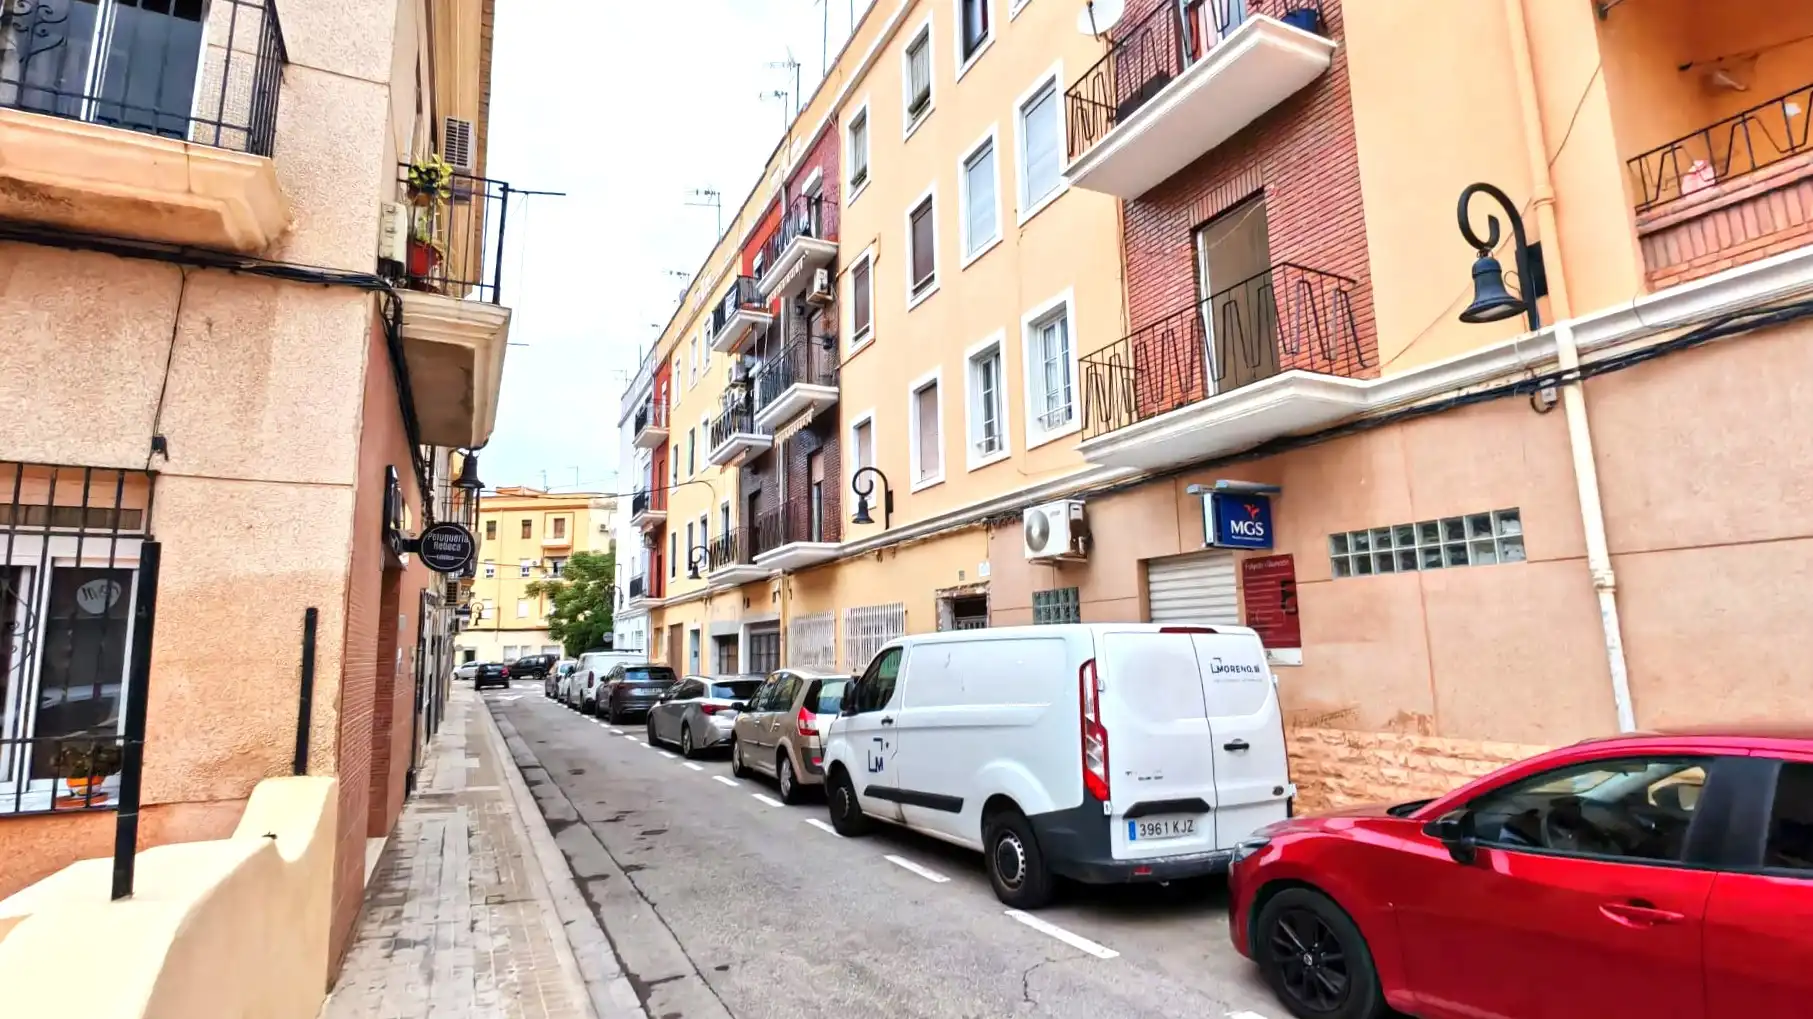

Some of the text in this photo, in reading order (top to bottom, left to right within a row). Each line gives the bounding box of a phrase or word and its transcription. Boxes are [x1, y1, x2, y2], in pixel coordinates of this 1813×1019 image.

[1230, 519, 1264, 536] MGS
[1139, 819, 1194, 837] 3961 KJZ
